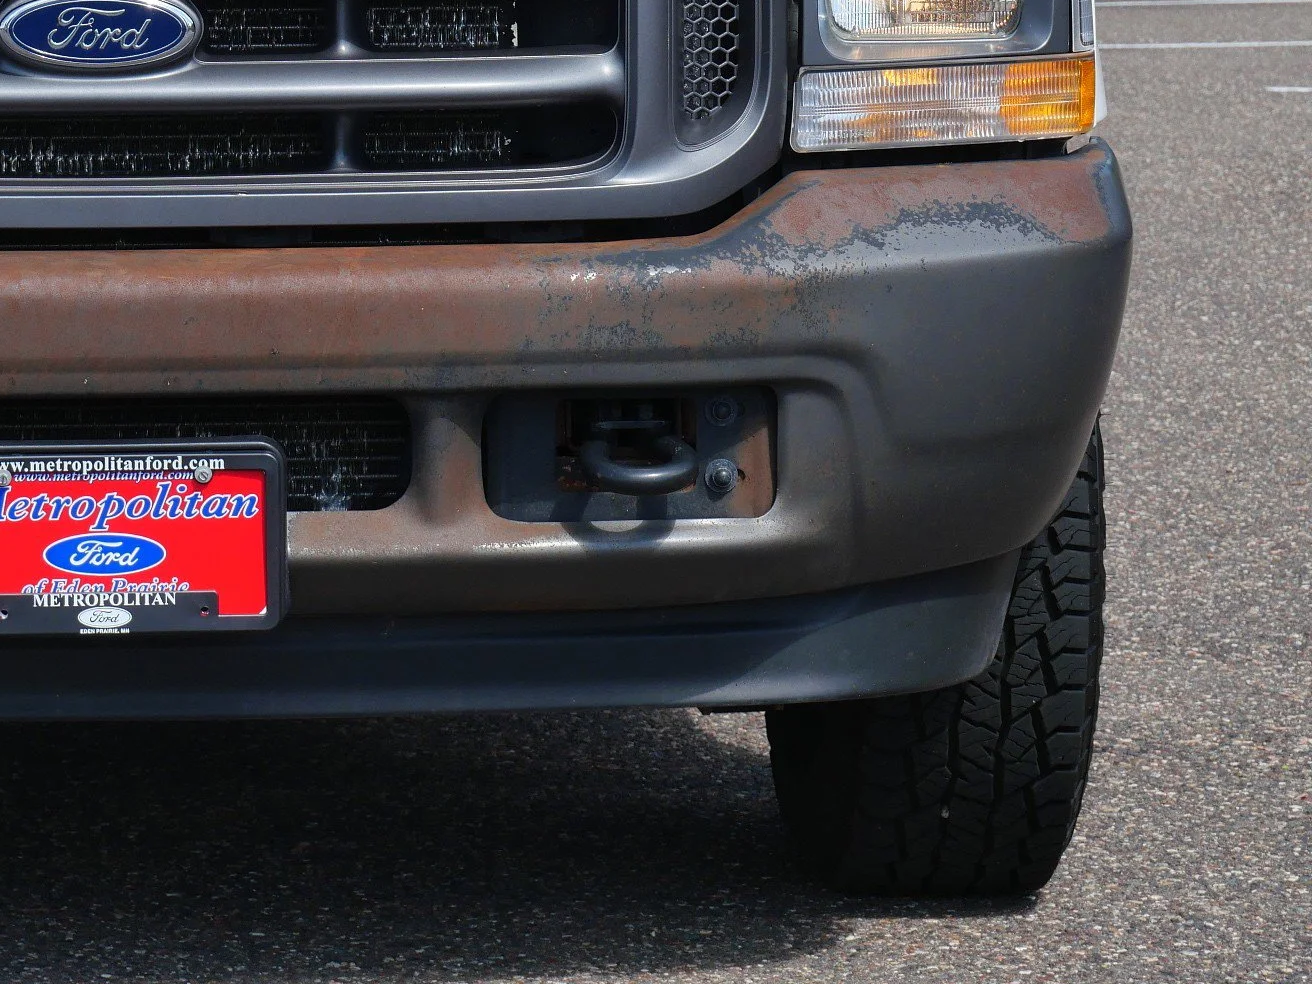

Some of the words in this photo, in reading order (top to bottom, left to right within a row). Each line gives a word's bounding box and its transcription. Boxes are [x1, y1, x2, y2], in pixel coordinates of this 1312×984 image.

[47, 6, 152, 50] Ford
[69, 540, 140, 566] Ford
[21, 578, 49, 594] of
[51, 578, 105, 593] Eden
[111, 577, 190, 593] Prairie
[33, 592, 176, 608] METROPOLITAN
[89, 610, 120, 623] Ford
